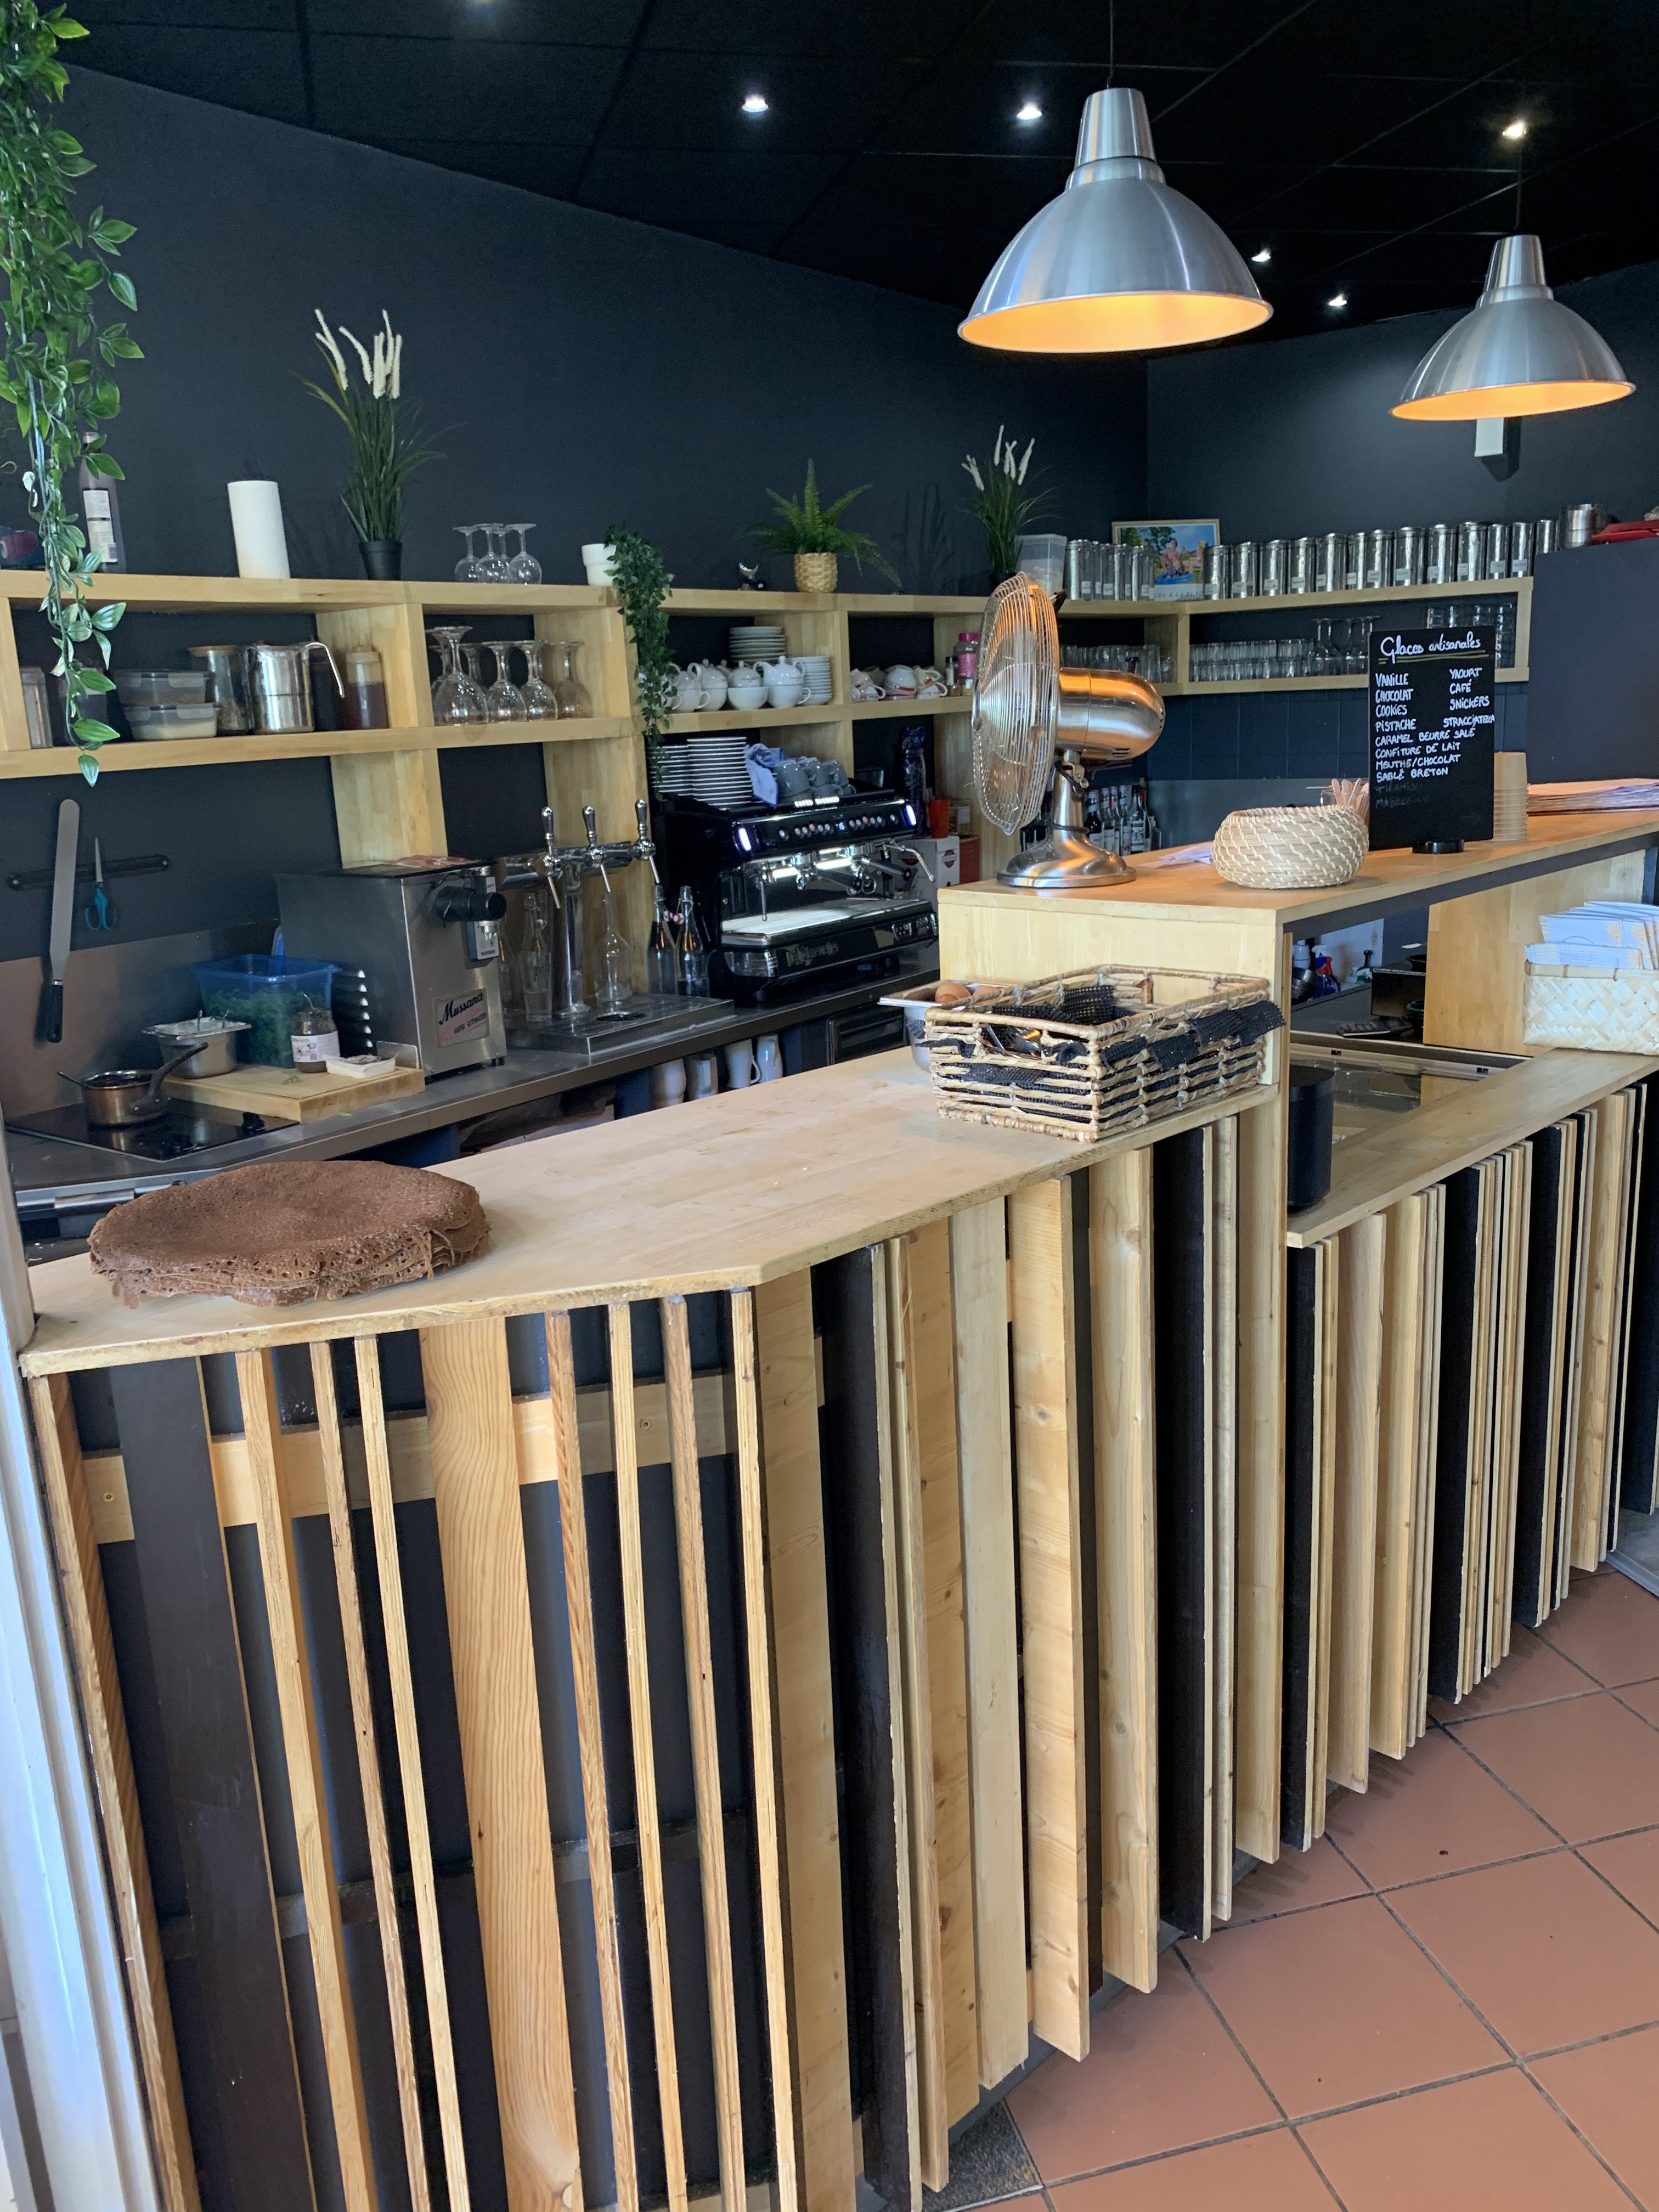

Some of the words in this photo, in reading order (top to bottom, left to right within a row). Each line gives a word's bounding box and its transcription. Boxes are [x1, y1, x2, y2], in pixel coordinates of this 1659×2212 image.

[1380, 635, 1424, 664] Glaces
[1429, 631, 1481, 652] artisanales
[1375, 673, 1409, 687] VANILLE
[1449, 667, 1482, 680] YAOURT
[1449, 679, 1472, 695] CAFÉ
[1375, 689, 1414, 703] CHOCOLAT
[1449, 696, 1489, 710] SNICKERS
[1375, 704, 1408, 718] COOKIES
[1375, 719, 1417, 732] PISTACHE
[1375, 734, 1413, 747] CARAMEL
[1419, 730, 1451, 742] BEURRE
[1375, 746, 1421, 759] CONFITURE
[1426, 742, 1439, 754] DE
[1442, 741, 1460, 752] LAIT
[1410, 767, 1448, 778] BRETON
[438, 992, 483, 1025] Mussana
